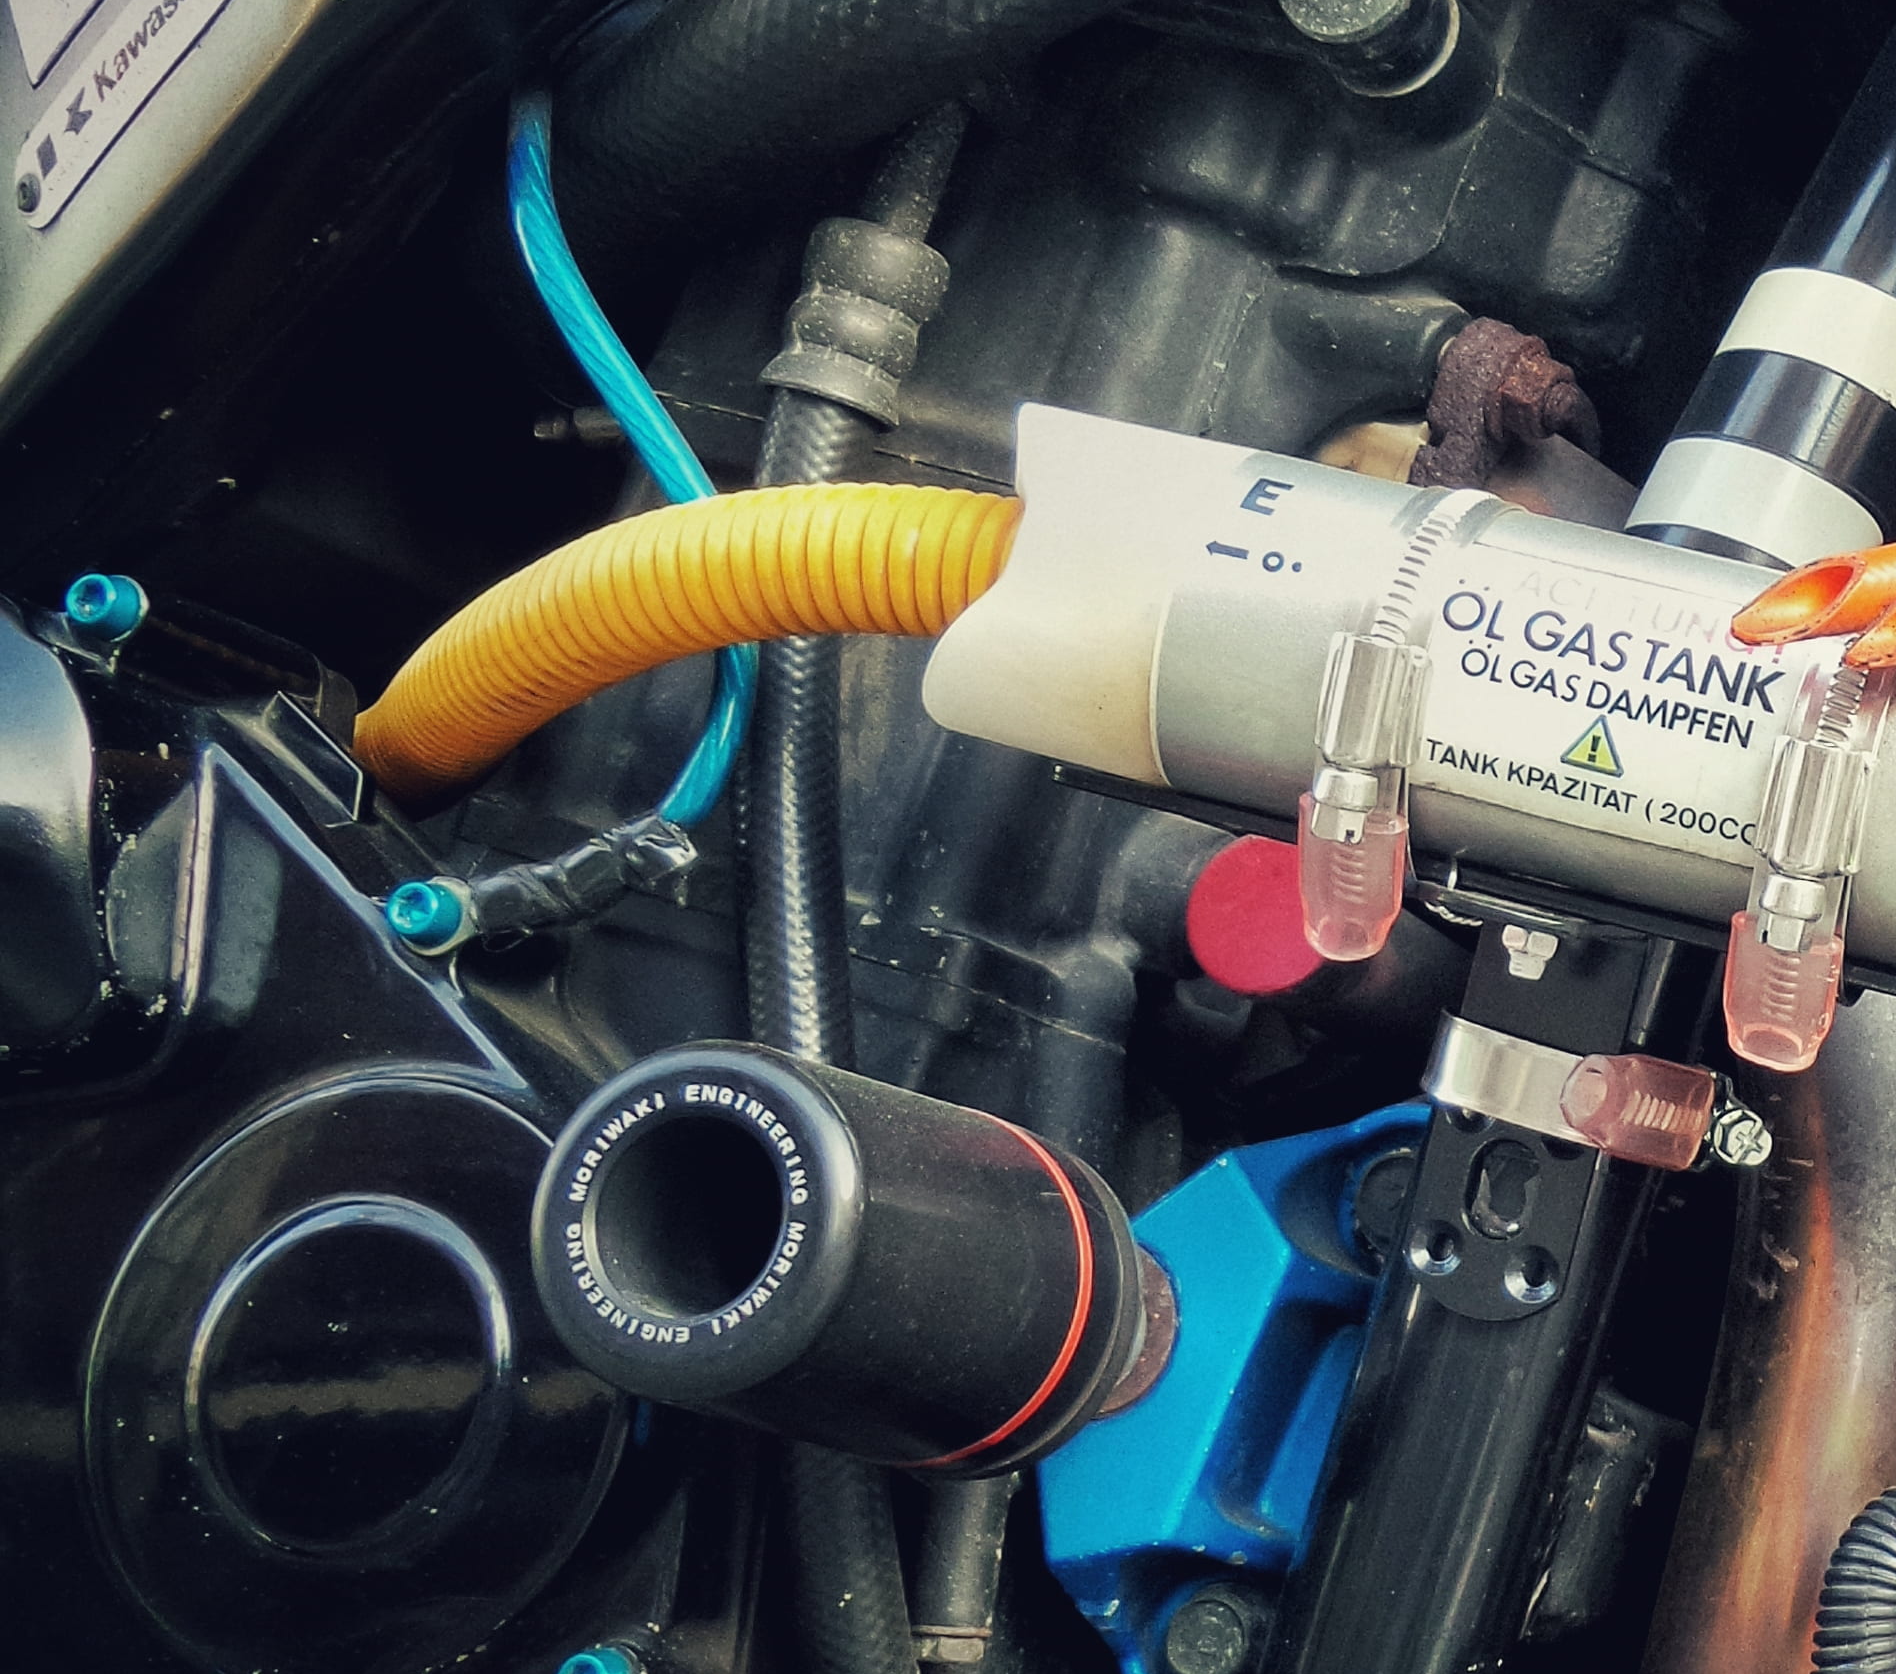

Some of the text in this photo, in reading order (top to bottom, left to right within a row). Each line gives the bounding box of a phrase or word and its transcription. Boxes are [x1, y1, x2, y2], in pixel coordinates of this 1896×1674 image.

[1240, 477, 1295, 516] E
[1442, 579, 1787, 714] ÖL GAS TANK
[1586, 679, 1754, 749] DAMPFEN
[1426, 737, 1500, 780] TANK
[1507, 758, 1638, 815] KPAZITAT
[568, 1083, 810, 1205] MORIWAKI ENGINEERING
[566, 1221, 806, 1343] MORIWAKI ENGINEERING
